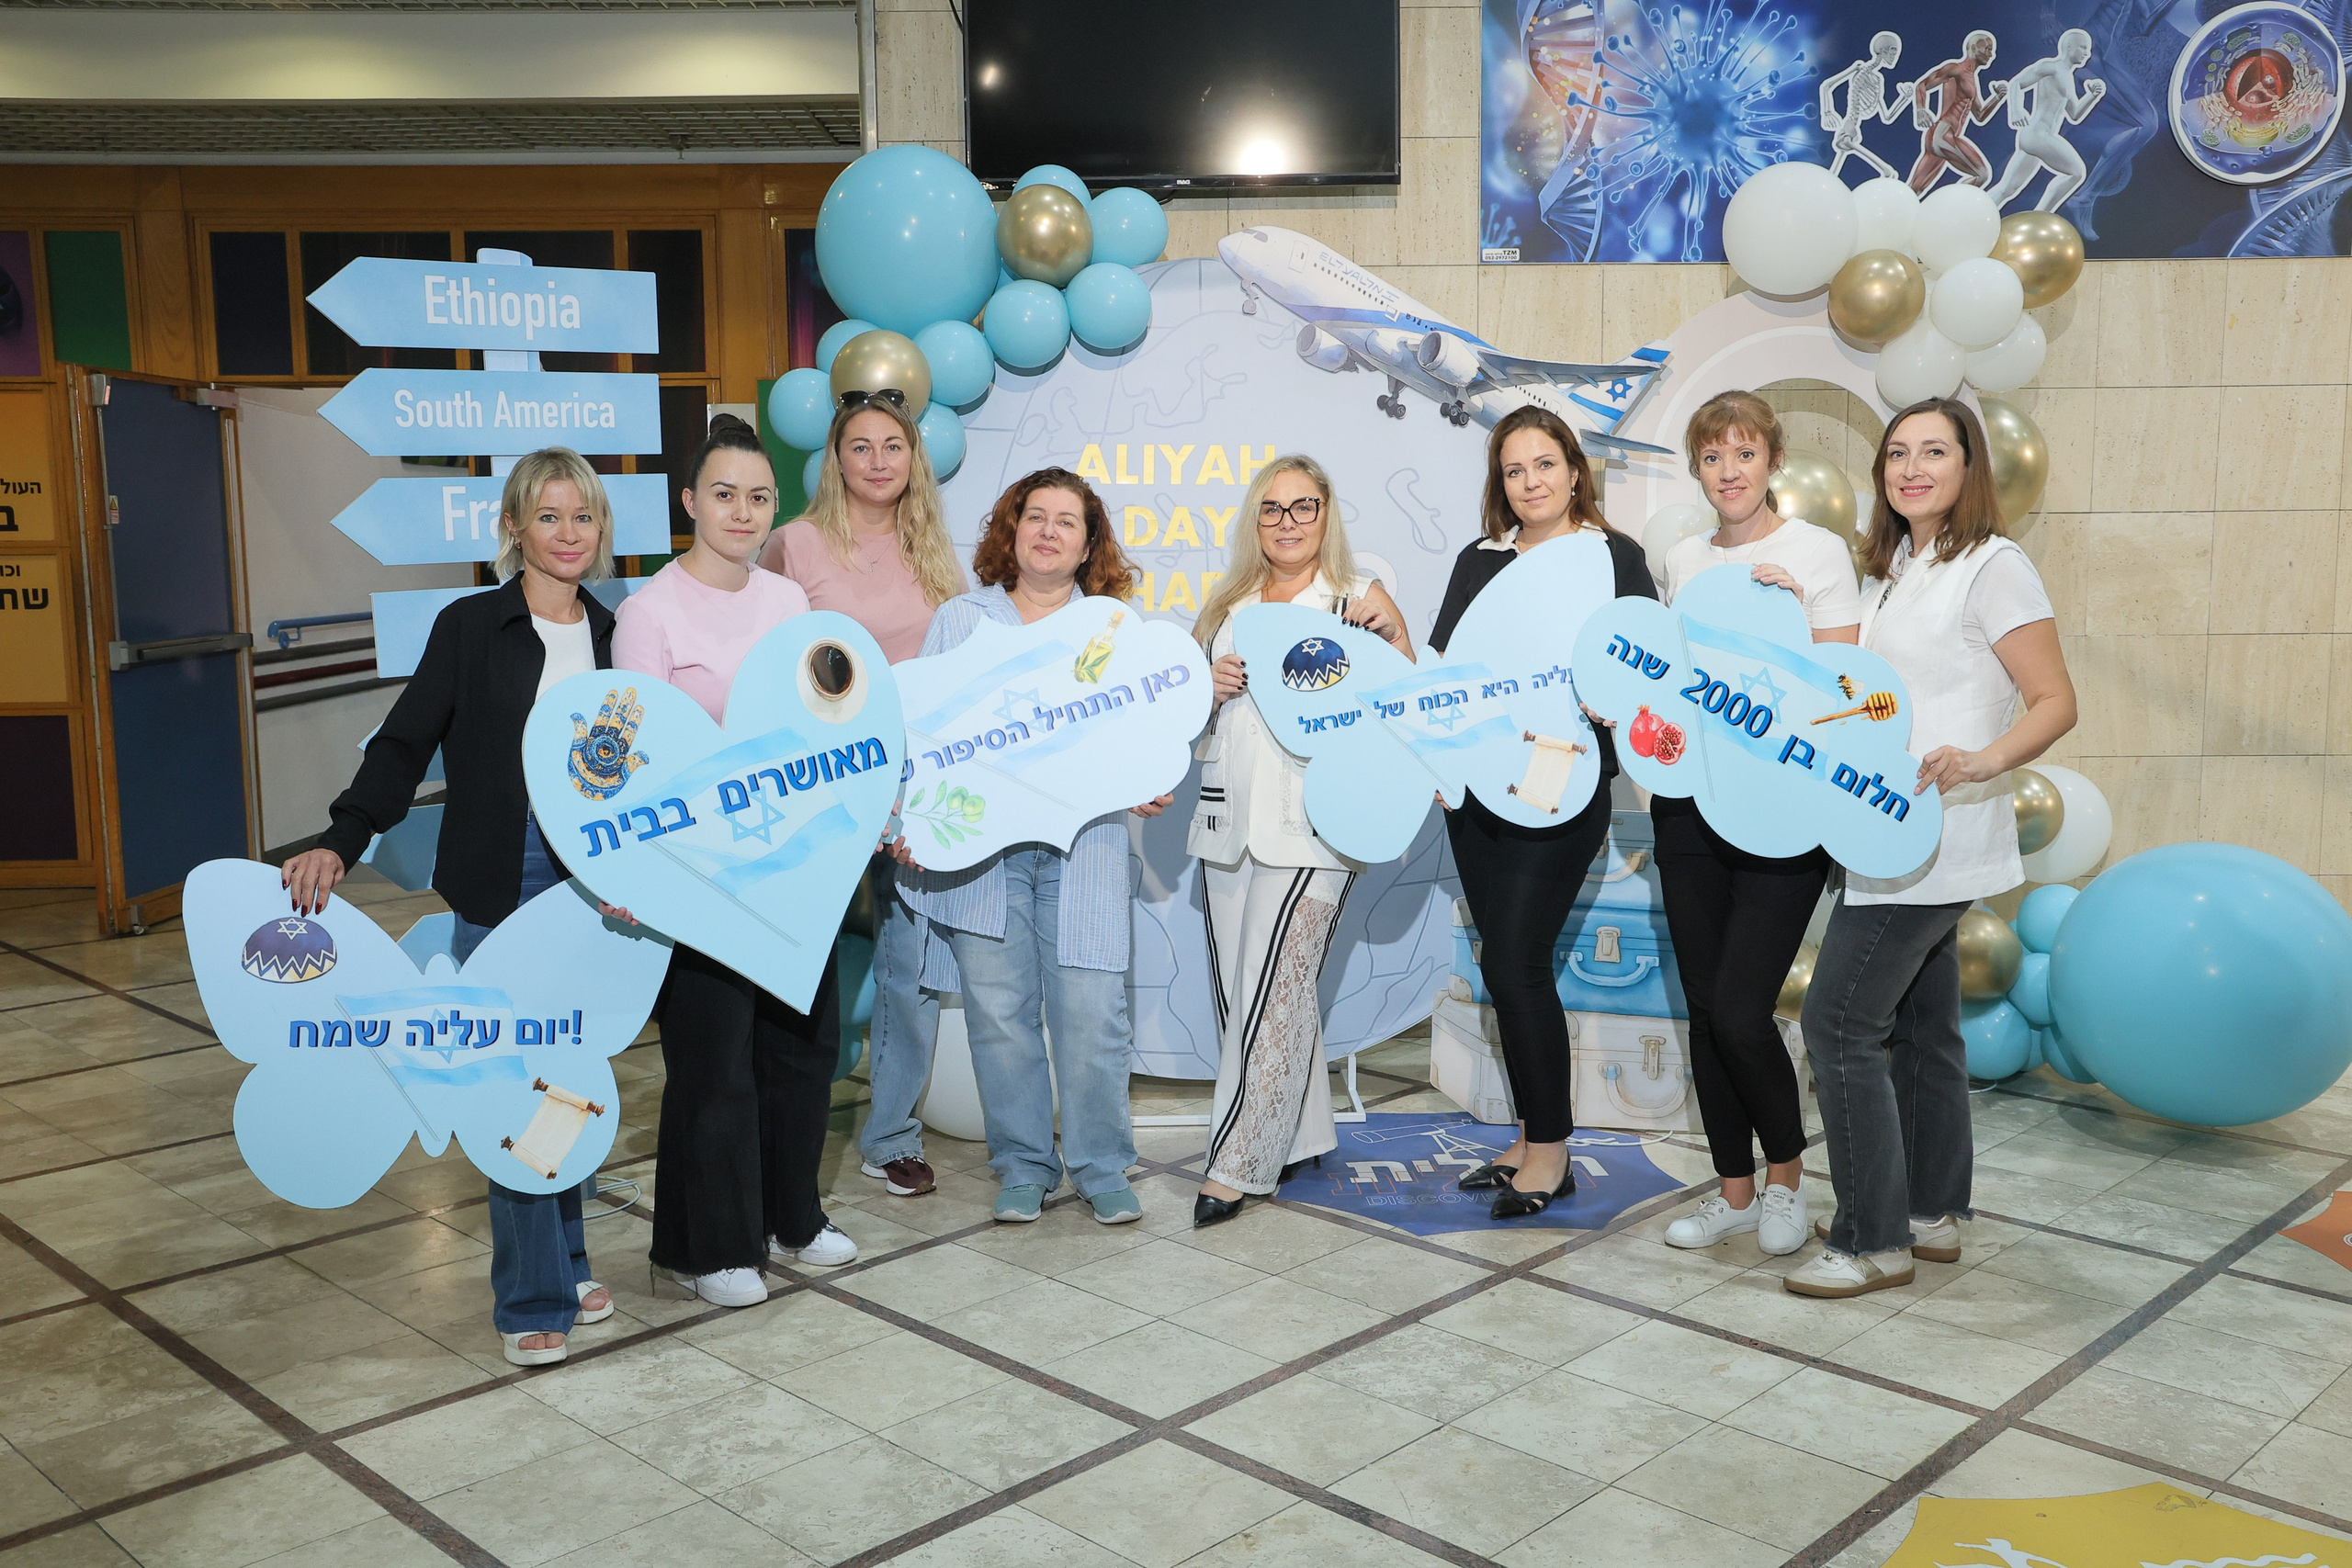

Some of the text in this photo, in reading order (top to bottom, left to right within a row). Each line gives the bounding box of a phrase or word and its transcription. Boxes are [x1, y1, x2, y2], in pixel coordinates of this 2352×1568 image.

[424, 275, 582, 340] Ethiopia
[394, 389, 616, 429] South America
[1074, 443, 1276, 485] ALIYAH
[442, 485, 502, 542] Fra
[1124, 505, 1239, 547] DAY
[1419, 689, 1469, 712] הכוח
[1481, 679, 1520, 699] היא
[922, 664, 1191, 770] כאן התחיל הסיפור
[1298, 710, 1363, 734] ישראל
[1374, 700, 1406, 719] של
[1607, 634, 1910, 823] חלום בן 2000 שנה
[580, 737, 888, 857] מאושרים בבית
[289, 1019, 390, 1048] שמח
[406, 1010, 501, 1049] עליה
[1366, 1192, 1501, 1206] DISCOVE
